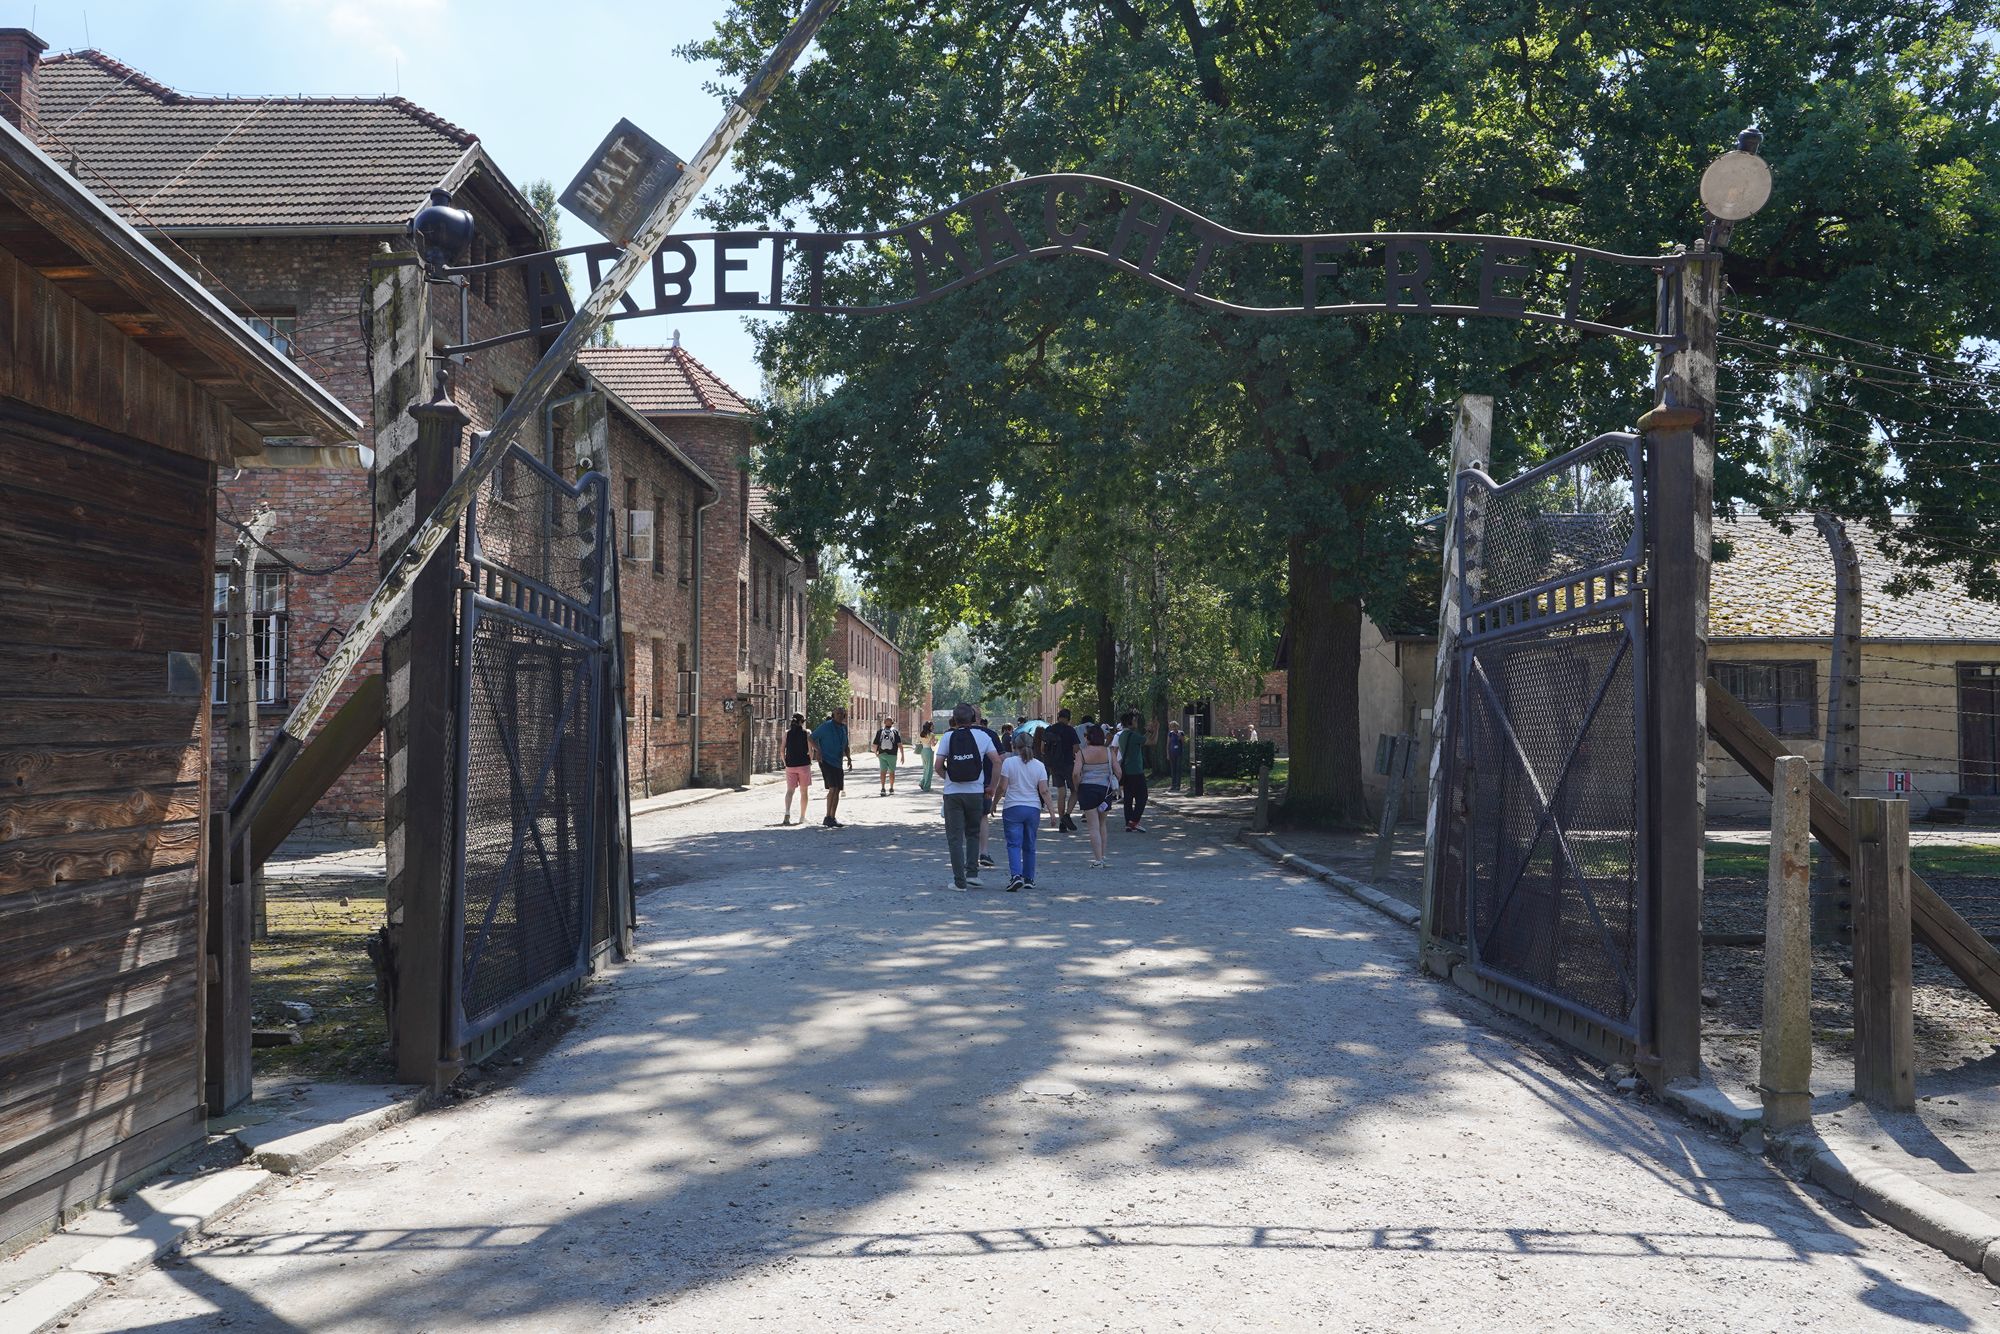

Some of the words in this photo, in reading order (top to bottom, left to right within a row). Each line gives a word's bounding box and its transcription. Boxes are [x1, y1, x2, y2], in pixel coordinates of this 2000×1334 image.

[575, 136, 641, 214] HALT
[527, 232, 843, 335] ARBEIT
[902, 176, 1240, 299] MACHT
[1301, 236, 1590, 322] FREI
